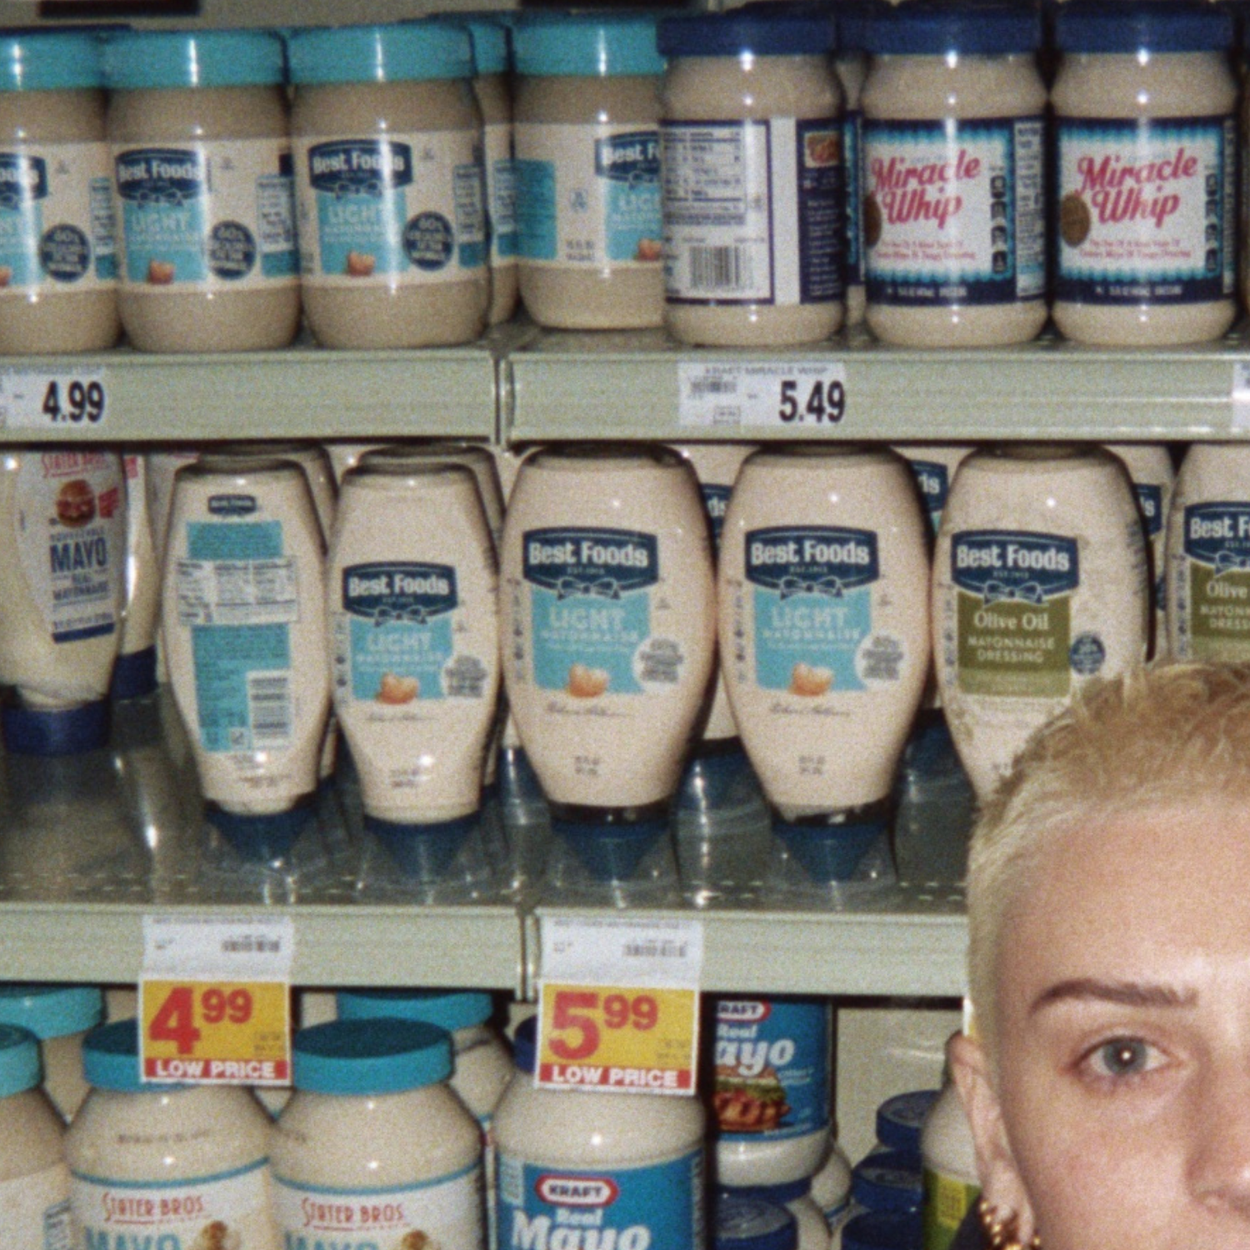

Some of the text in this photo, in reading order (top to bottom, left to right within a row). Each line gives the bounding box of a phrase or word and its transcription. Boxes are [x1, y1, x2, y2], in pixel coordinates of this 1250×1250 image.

[118, 160, 201, 181] Best Foods
[313, 154, 346, 173] Best
[870, 148, 981, 196] Miracle
[1074, 147, 1198, 197] Miracle
[882, 186, 963, 230] Whip
[1091, 185, 1181, 229] Whip
[42, 380, 105, 422] 4.99
[779, 380, 845, 423] 5.49
[1190, 517, 1233, 539] Best
[51, 537, 107, 573] MAYO
[529, 542, 648, 567] Best Foods
[751, 540, 869, 565] Best Foods
[957, 545, 1070, 571] Best Foods
[349, 576, 449, 596] Best Foods
[1206, 581, 1247, 599] Olive
[551, 608, 626, 630] LIGHT
[772, 606, 847, 628] LIGHT
[974, 611, 1050, 630] Olive Oil
[367, 632, 432, 649] LIGHT
[967, 637, 1055, 650] MAYONNAISE
[977, 650, 1044, 663] DRESSING
[156, 1060, 276, 1078] LOW PRICE
[716, 1039, 796, 1077] ayo
[552, 1066, 679, 1088] LOW PRICE
[549, 1185, 602, 1198] KRAFT
[102, 1192, 203, 1222] STATER BROS
[301, 1197, 404, 1227] STATER BROS
[556, 1208, 603, 1225] Real
